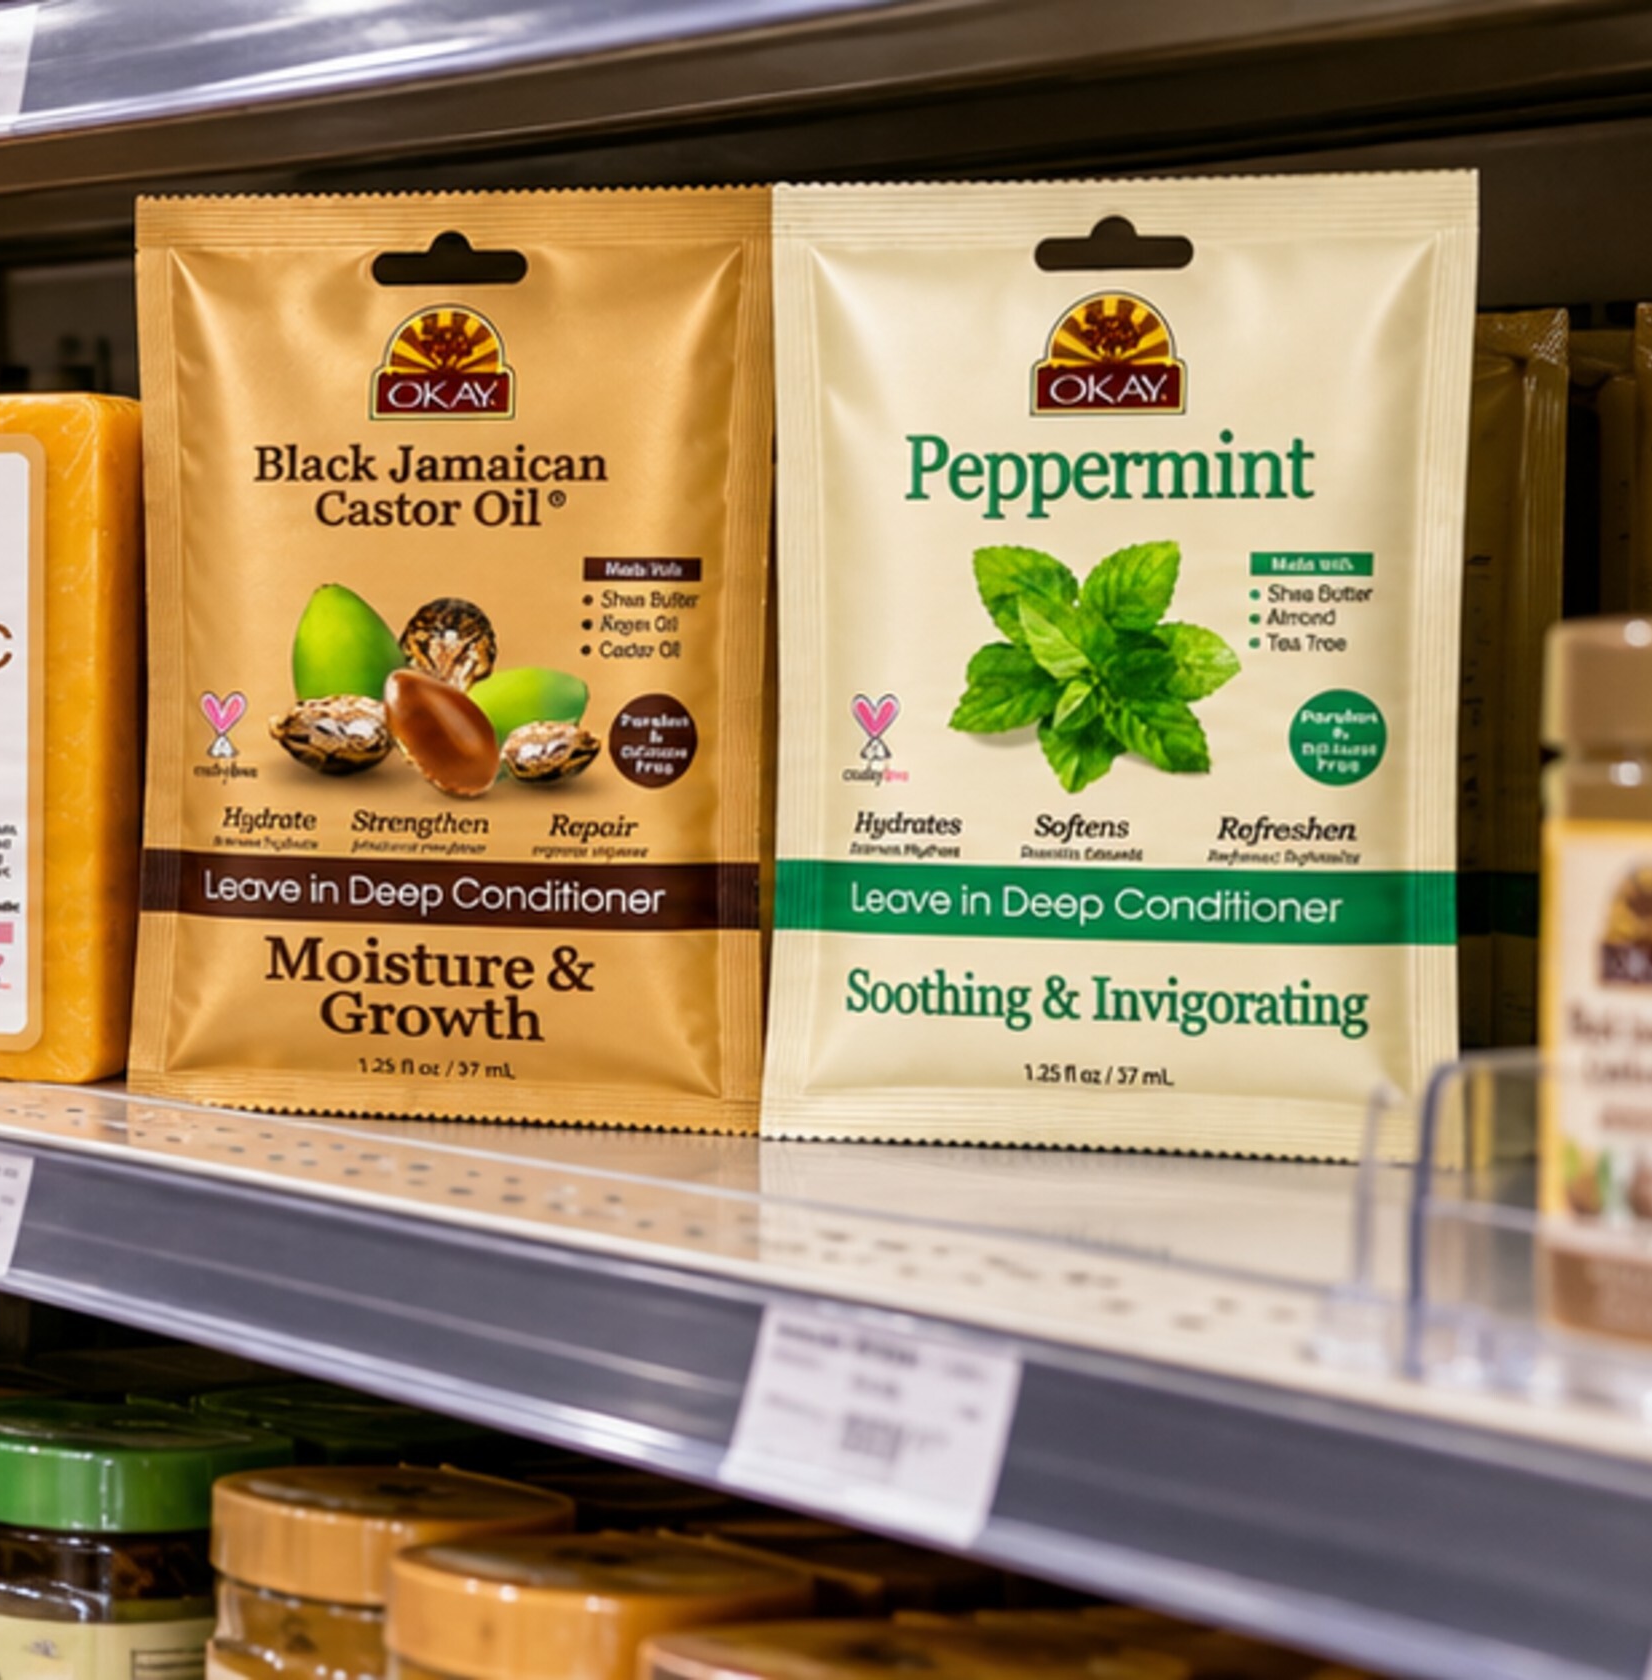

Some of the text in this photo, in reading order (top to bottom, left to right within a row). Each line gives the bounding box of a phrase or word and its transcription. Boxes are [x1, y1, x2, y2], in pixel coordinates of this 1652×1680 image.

[253, 443, 608, 484] Black Jamaican
[904, 429, 1315, 519] Peppermint
[315, 490, 462, 527] Castor
[1266, 608, 1336, 626] Almond
[351, 810, 490, 838] Strengthen
[853, 811, 962, 839] Hydrates
[1034, 814, 1130, 843] Softens
[203, 870, 666, 915] Leave in Deep Conditioner
[850, 881, 1343, 926] Leave in Deep Conditioner
[264, 935, 596, 992] Moisture &
[320, 990, 546, 1042] Growth
[845, 968, 1370, 1040] Soothing & Invigorating
